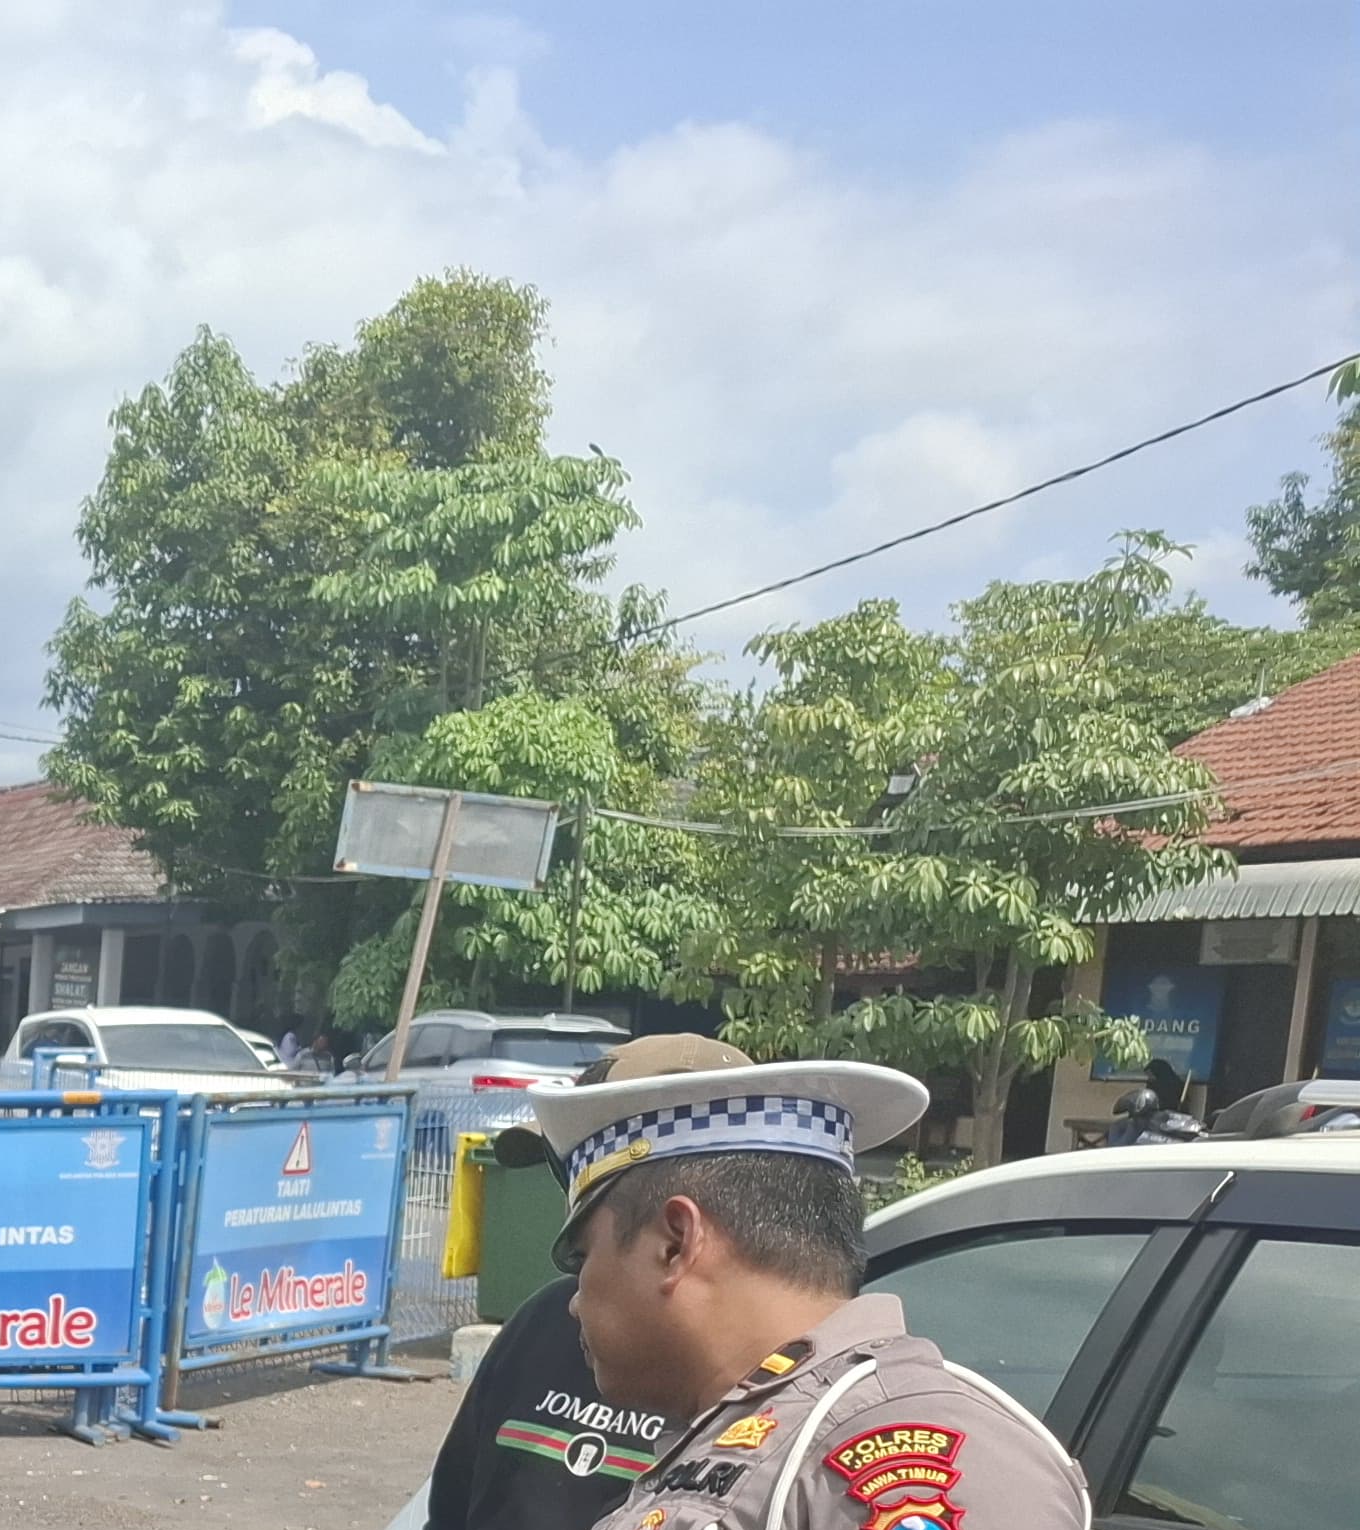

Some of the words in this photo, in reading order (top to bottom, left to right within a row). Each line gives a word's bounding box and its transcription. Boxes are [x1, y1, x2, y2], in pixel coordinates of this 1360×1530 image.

[1137, 1018, 1201, 1033] DANG
[276, 1179, 311, 1198] TAATI
[223, 1204, 290, 1227] PERATURAN
[292, 1199, 363, 1220] LALULINTAS
[230, 1272, 255, 1322] Le
[256, 1258, 367, 1314] Minerale
[535, 1390, 666, 1441] JOMBANG
[838, 1429, 949, 1466] POLRES
[853, 1444, 940, 1469] JOMBANG
[861, 1471, 898, 1496] JAWA
[897, 1467, 949, 1484] TIMUR
